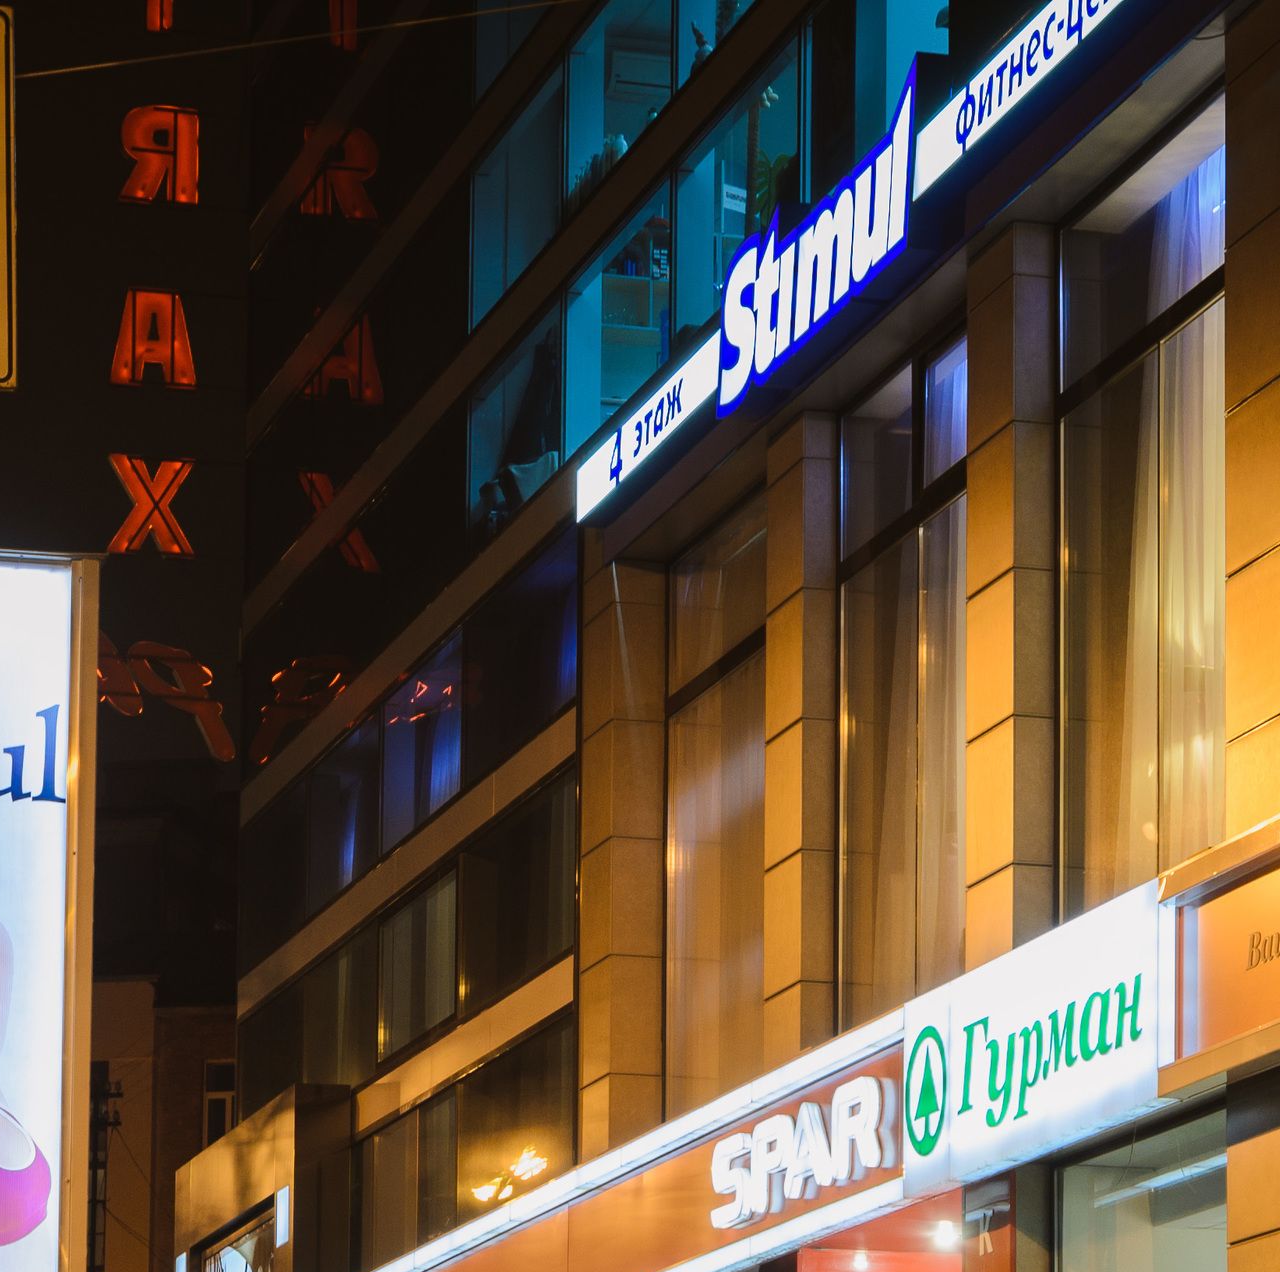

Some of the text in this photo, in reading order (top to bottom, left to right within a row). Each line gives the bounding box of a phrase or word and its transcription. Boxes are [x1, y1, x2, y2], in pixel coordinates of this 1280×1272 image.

[720, 84, 913, 406] Stimul
[608, 377, 683, 488] 4 этаж
[957, 973, 1143, 1128] Гурман
[710, 1076, 884, 1230] SPAR
